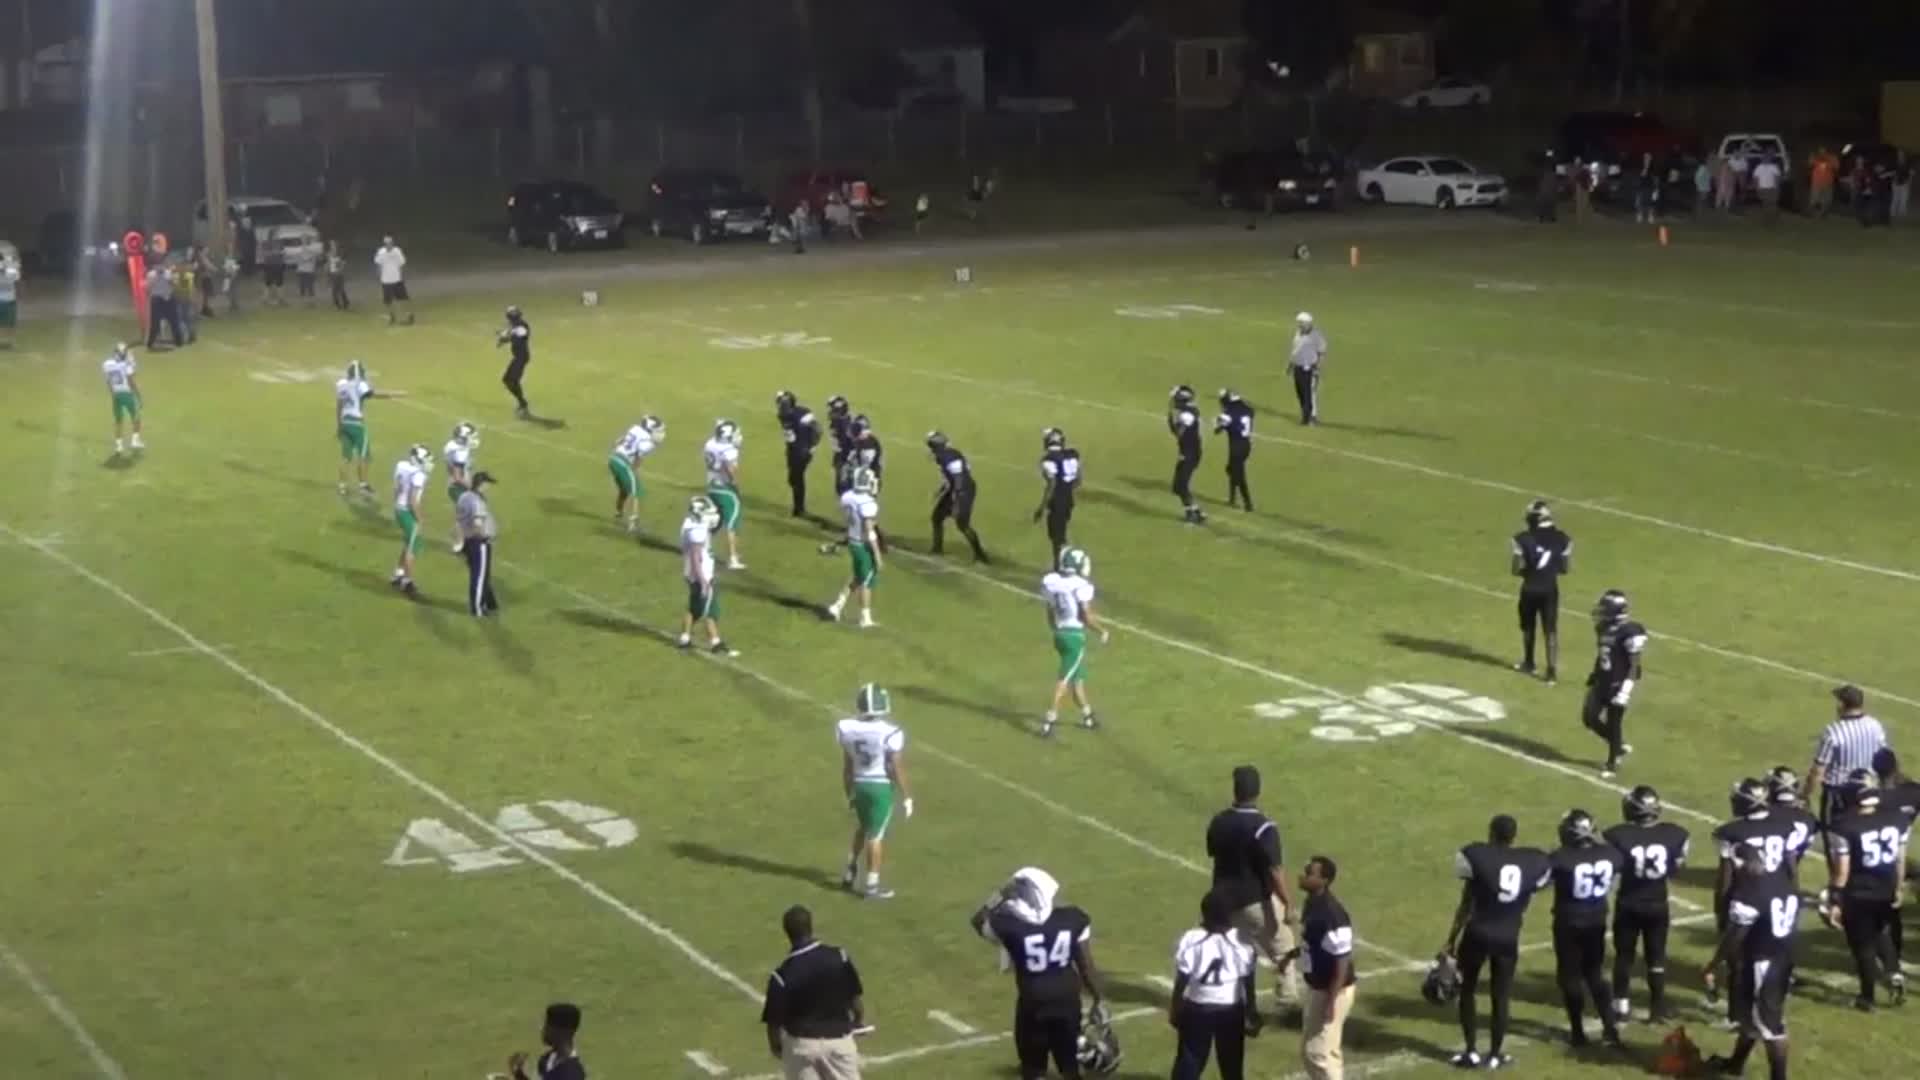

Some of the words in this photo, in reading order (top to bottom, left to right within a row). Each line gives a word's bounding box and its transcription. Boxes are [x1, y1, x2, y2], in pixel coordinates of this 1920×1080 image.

[1536, 545, 1551, 569] 7
[1252, 682, 1507, 742] 30
[854, 738, 874, 768] 5
[382, 800, 639, 873] 40
[1861, 826, 1900, 867] 53
[1573, 859, 1613, 899] 63
[1630, 843, 1668, 880] 13
[1498, 864, 1522, 904] 9
[1023, 930, 1072, 972] 54
